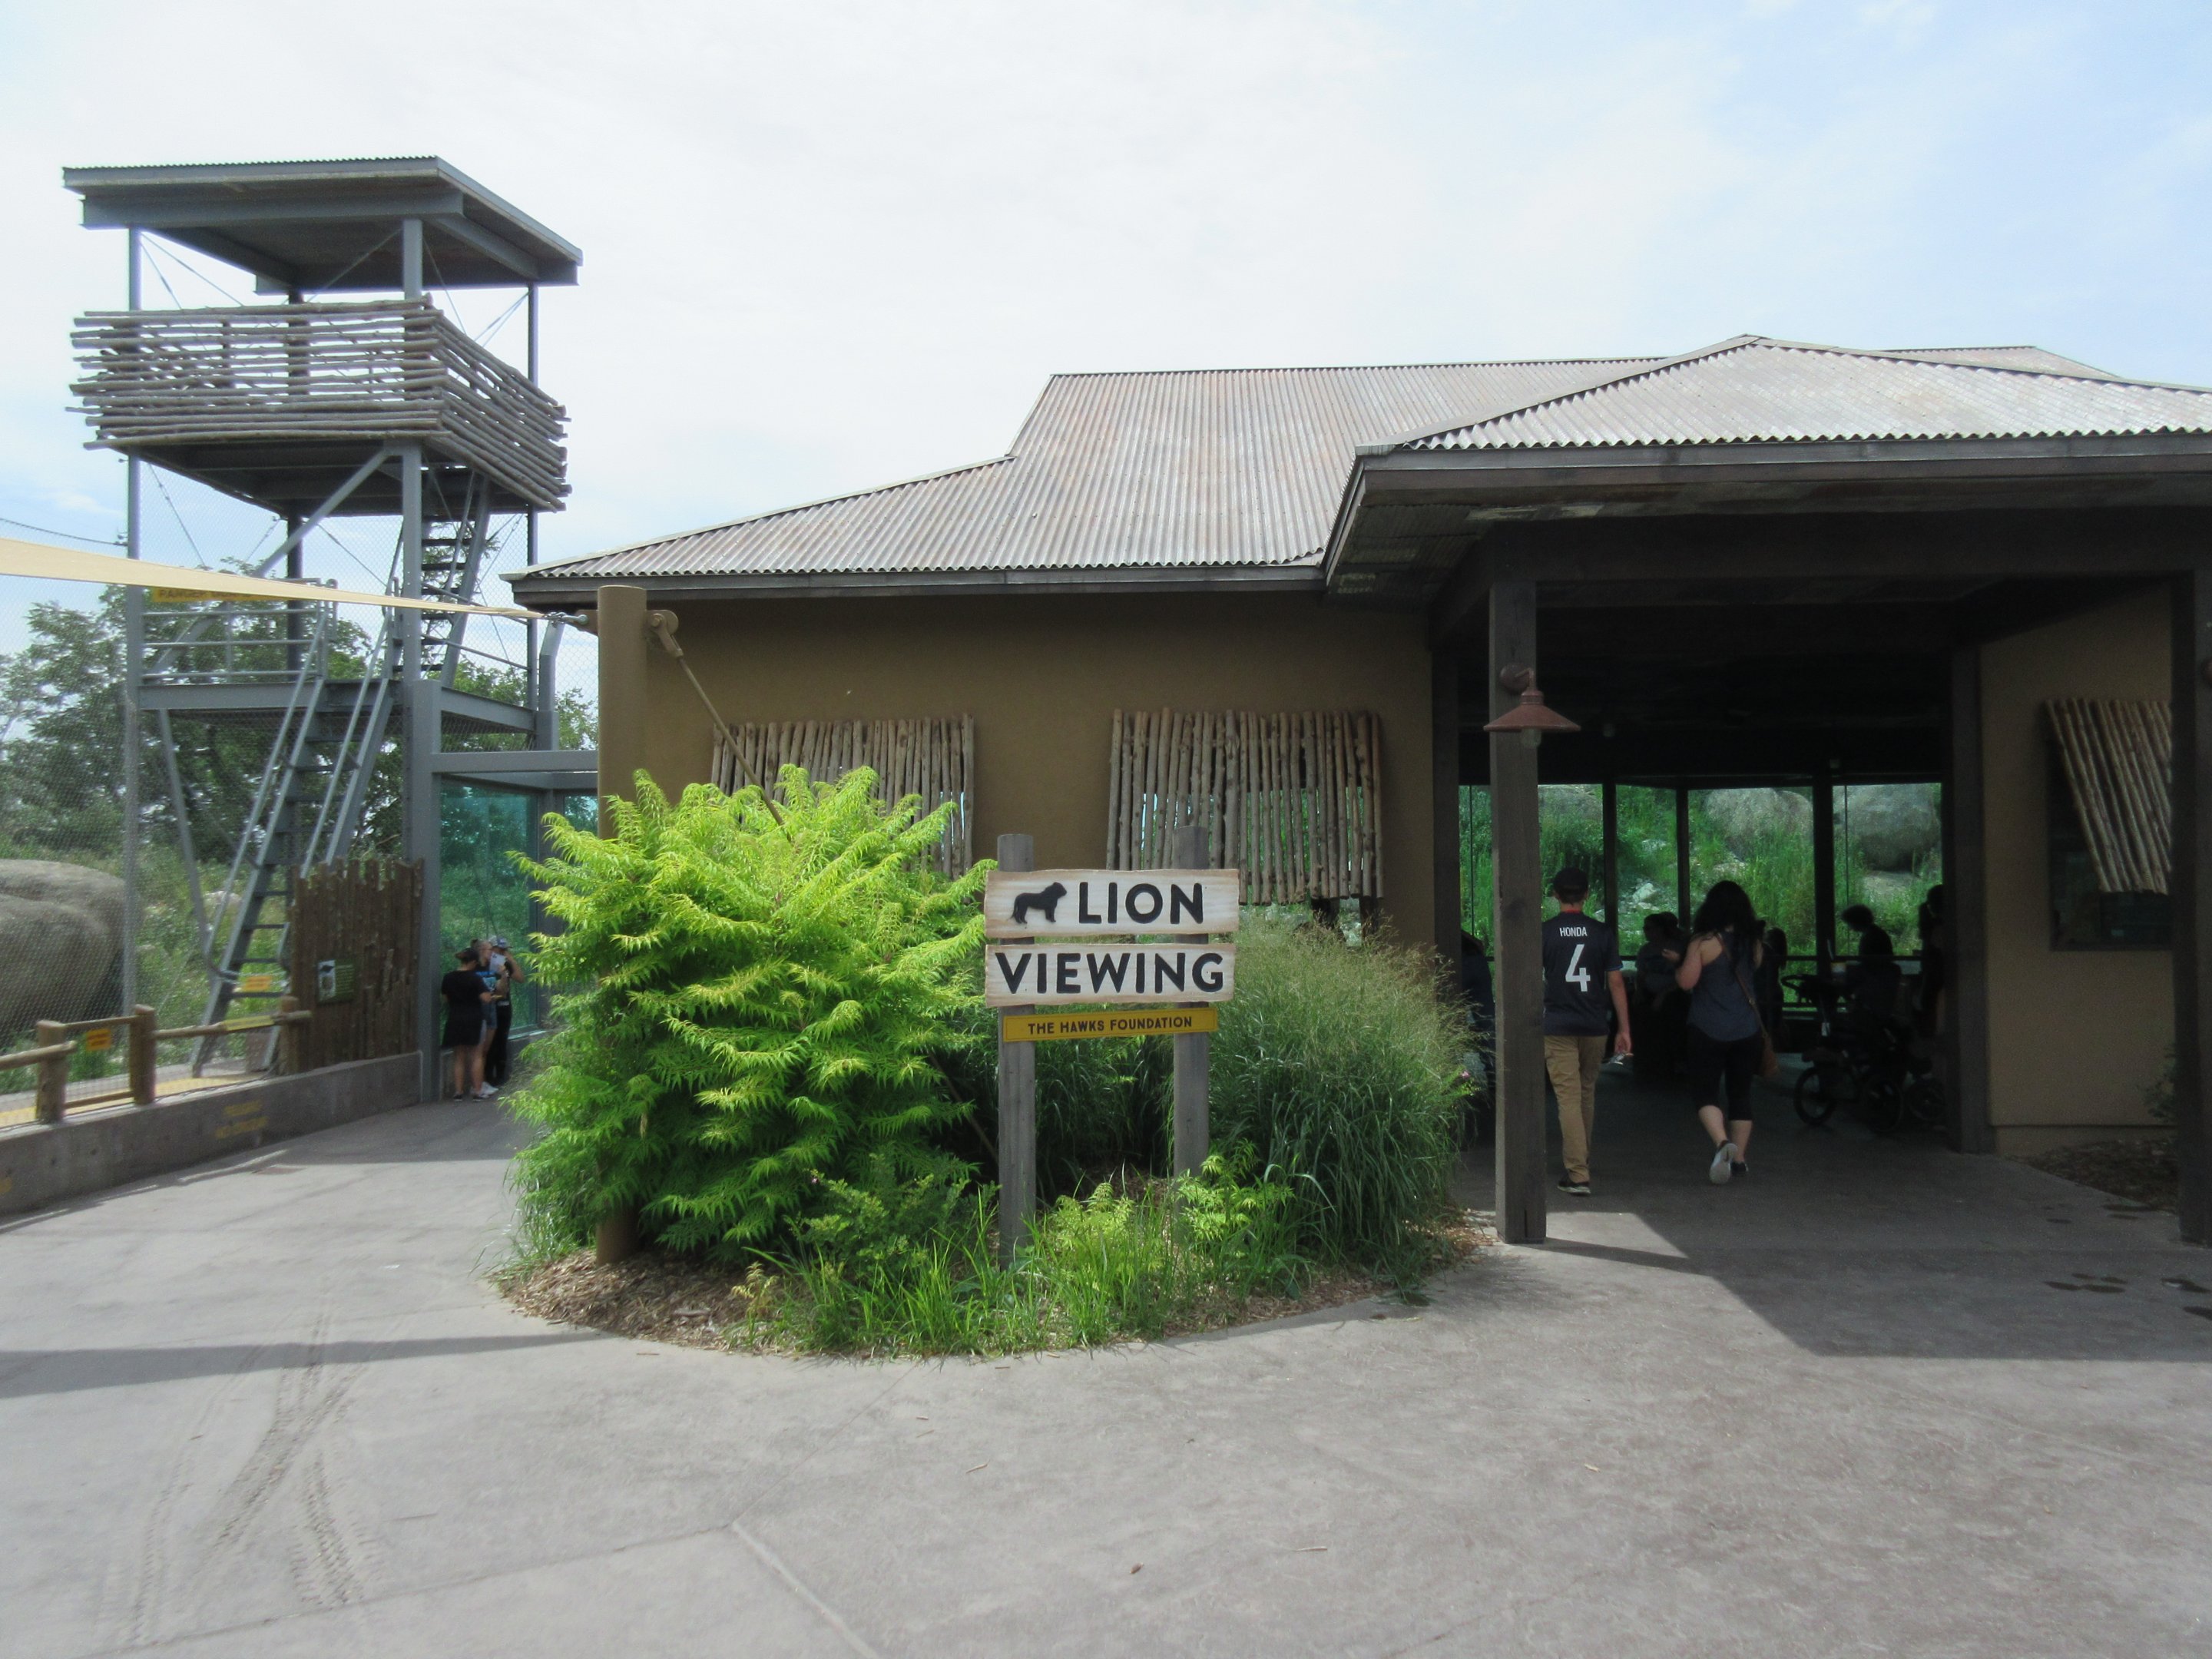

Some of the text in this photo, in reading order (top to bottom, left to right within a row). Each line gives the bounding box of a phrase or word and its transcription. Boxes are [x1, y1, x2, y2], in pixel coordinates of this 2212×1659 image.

[1078, 882, 1204, 924] LION
[1559, 926, 1588, 937] HONDA
[995, 952, 1224, 994] VIEWING
[1565, 944, 1591, 992] 4
[1028, 1016, 1192, 1035] THE HAWKS FOUNDATION
